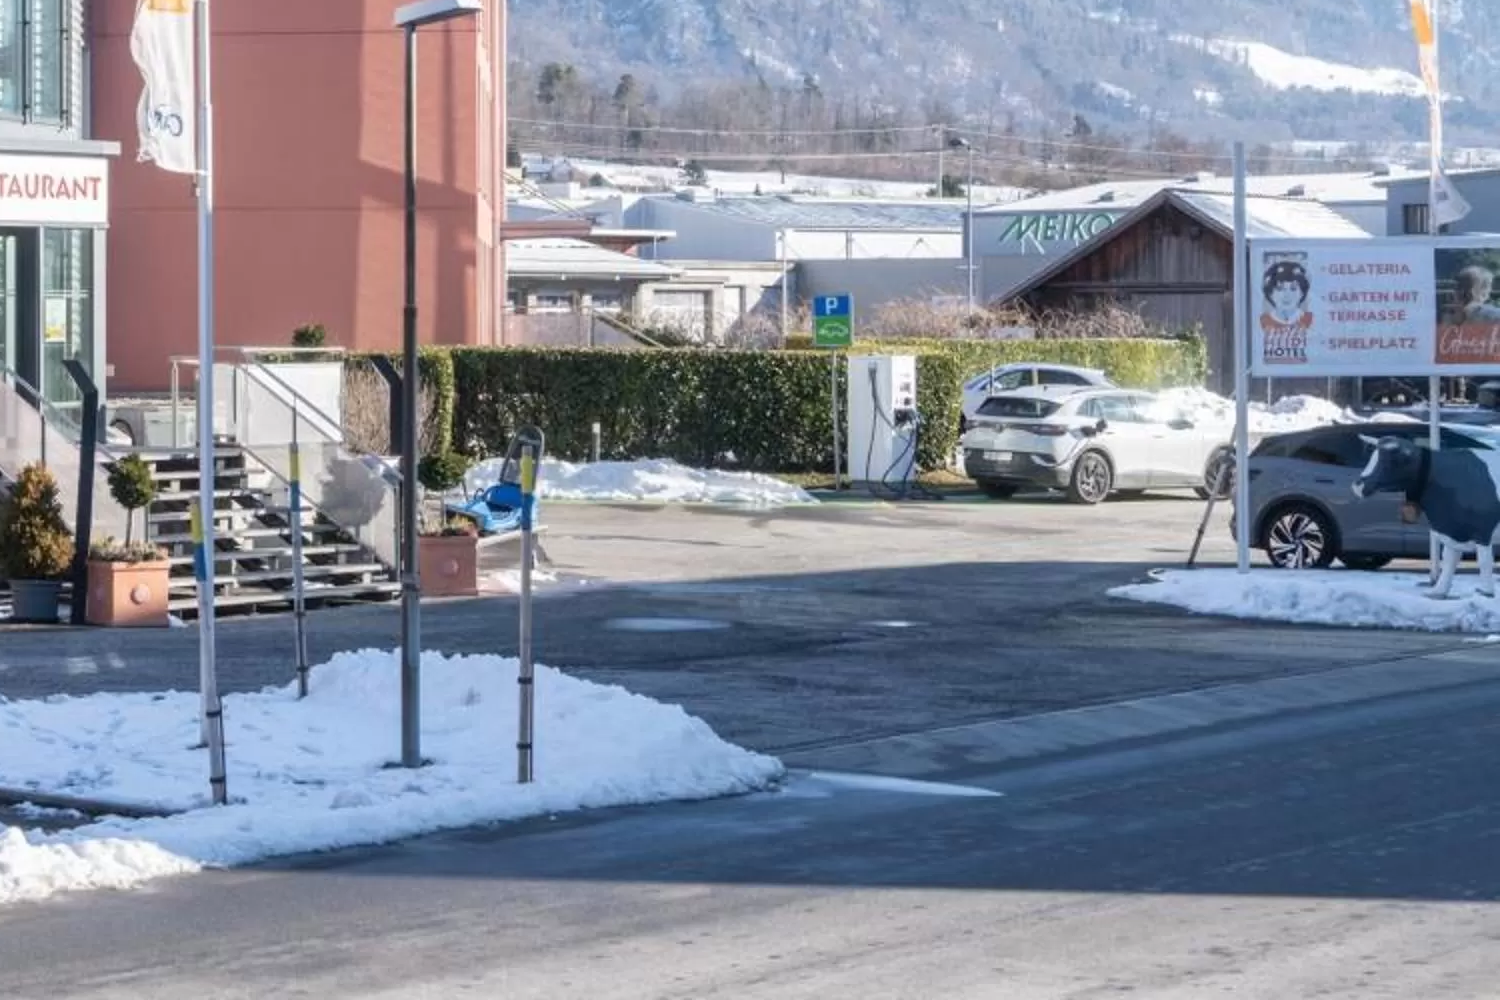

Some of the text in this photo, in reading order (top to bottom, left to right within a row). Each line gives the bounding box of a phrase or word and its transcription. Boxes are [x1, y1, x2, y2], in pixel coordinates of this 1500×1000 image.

[1328, 263, 1411, 275] GELATERIA
[1328, 291, 1419, 303] GARTEN MIT
[825, 296, 838, 315] P
[1328, 310, 1407, 321] TERRASSE
[1328, 337, 1417, 350] SPIELPLATZ
[1263, 347, 1307, 357] HOTEL
